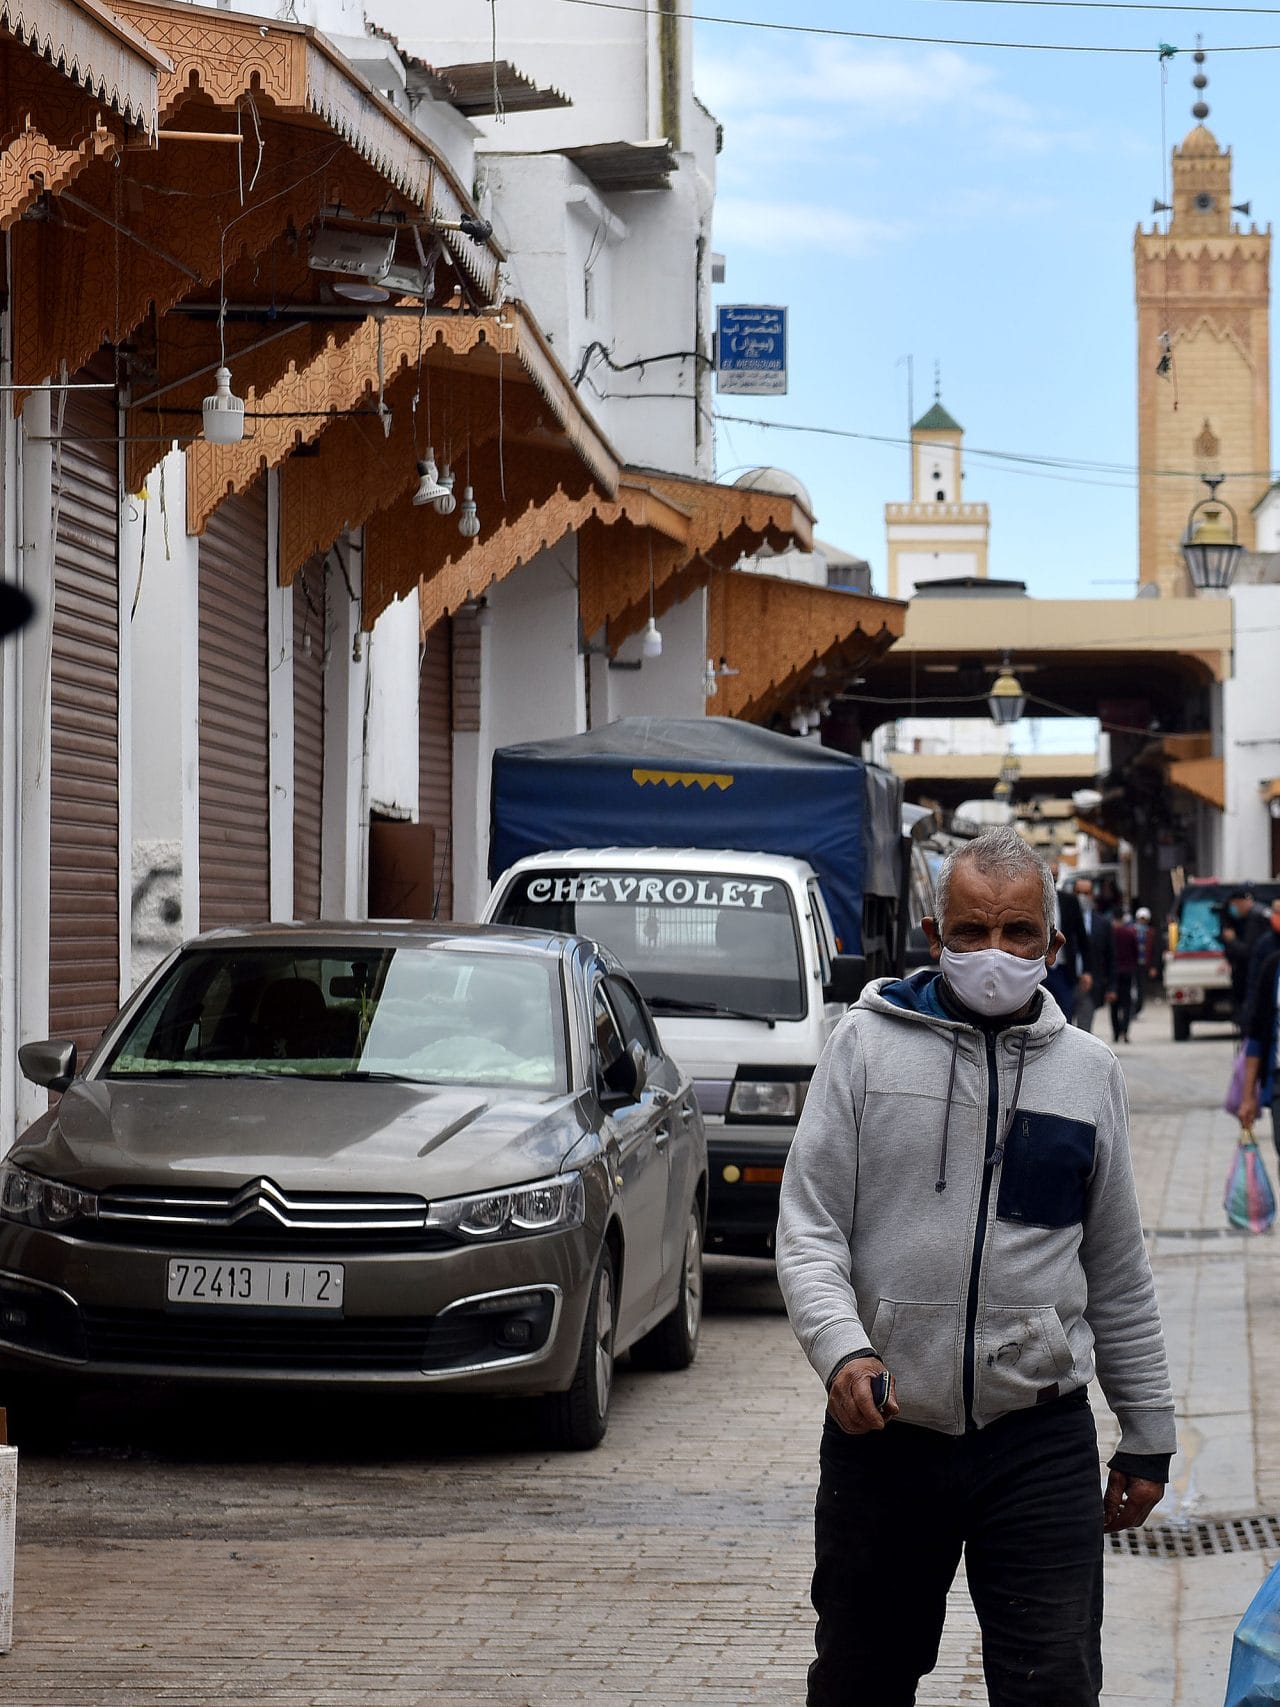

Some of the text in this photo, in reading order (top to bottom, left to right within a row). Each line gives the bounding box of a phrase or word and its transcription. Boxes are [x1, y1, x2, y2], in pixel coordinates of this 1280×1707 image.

[527, 877, 774, 909] CHEVROLET
[176, 1264, 252, 1299] 72413
[316, 1269, 331, 1301] 2
